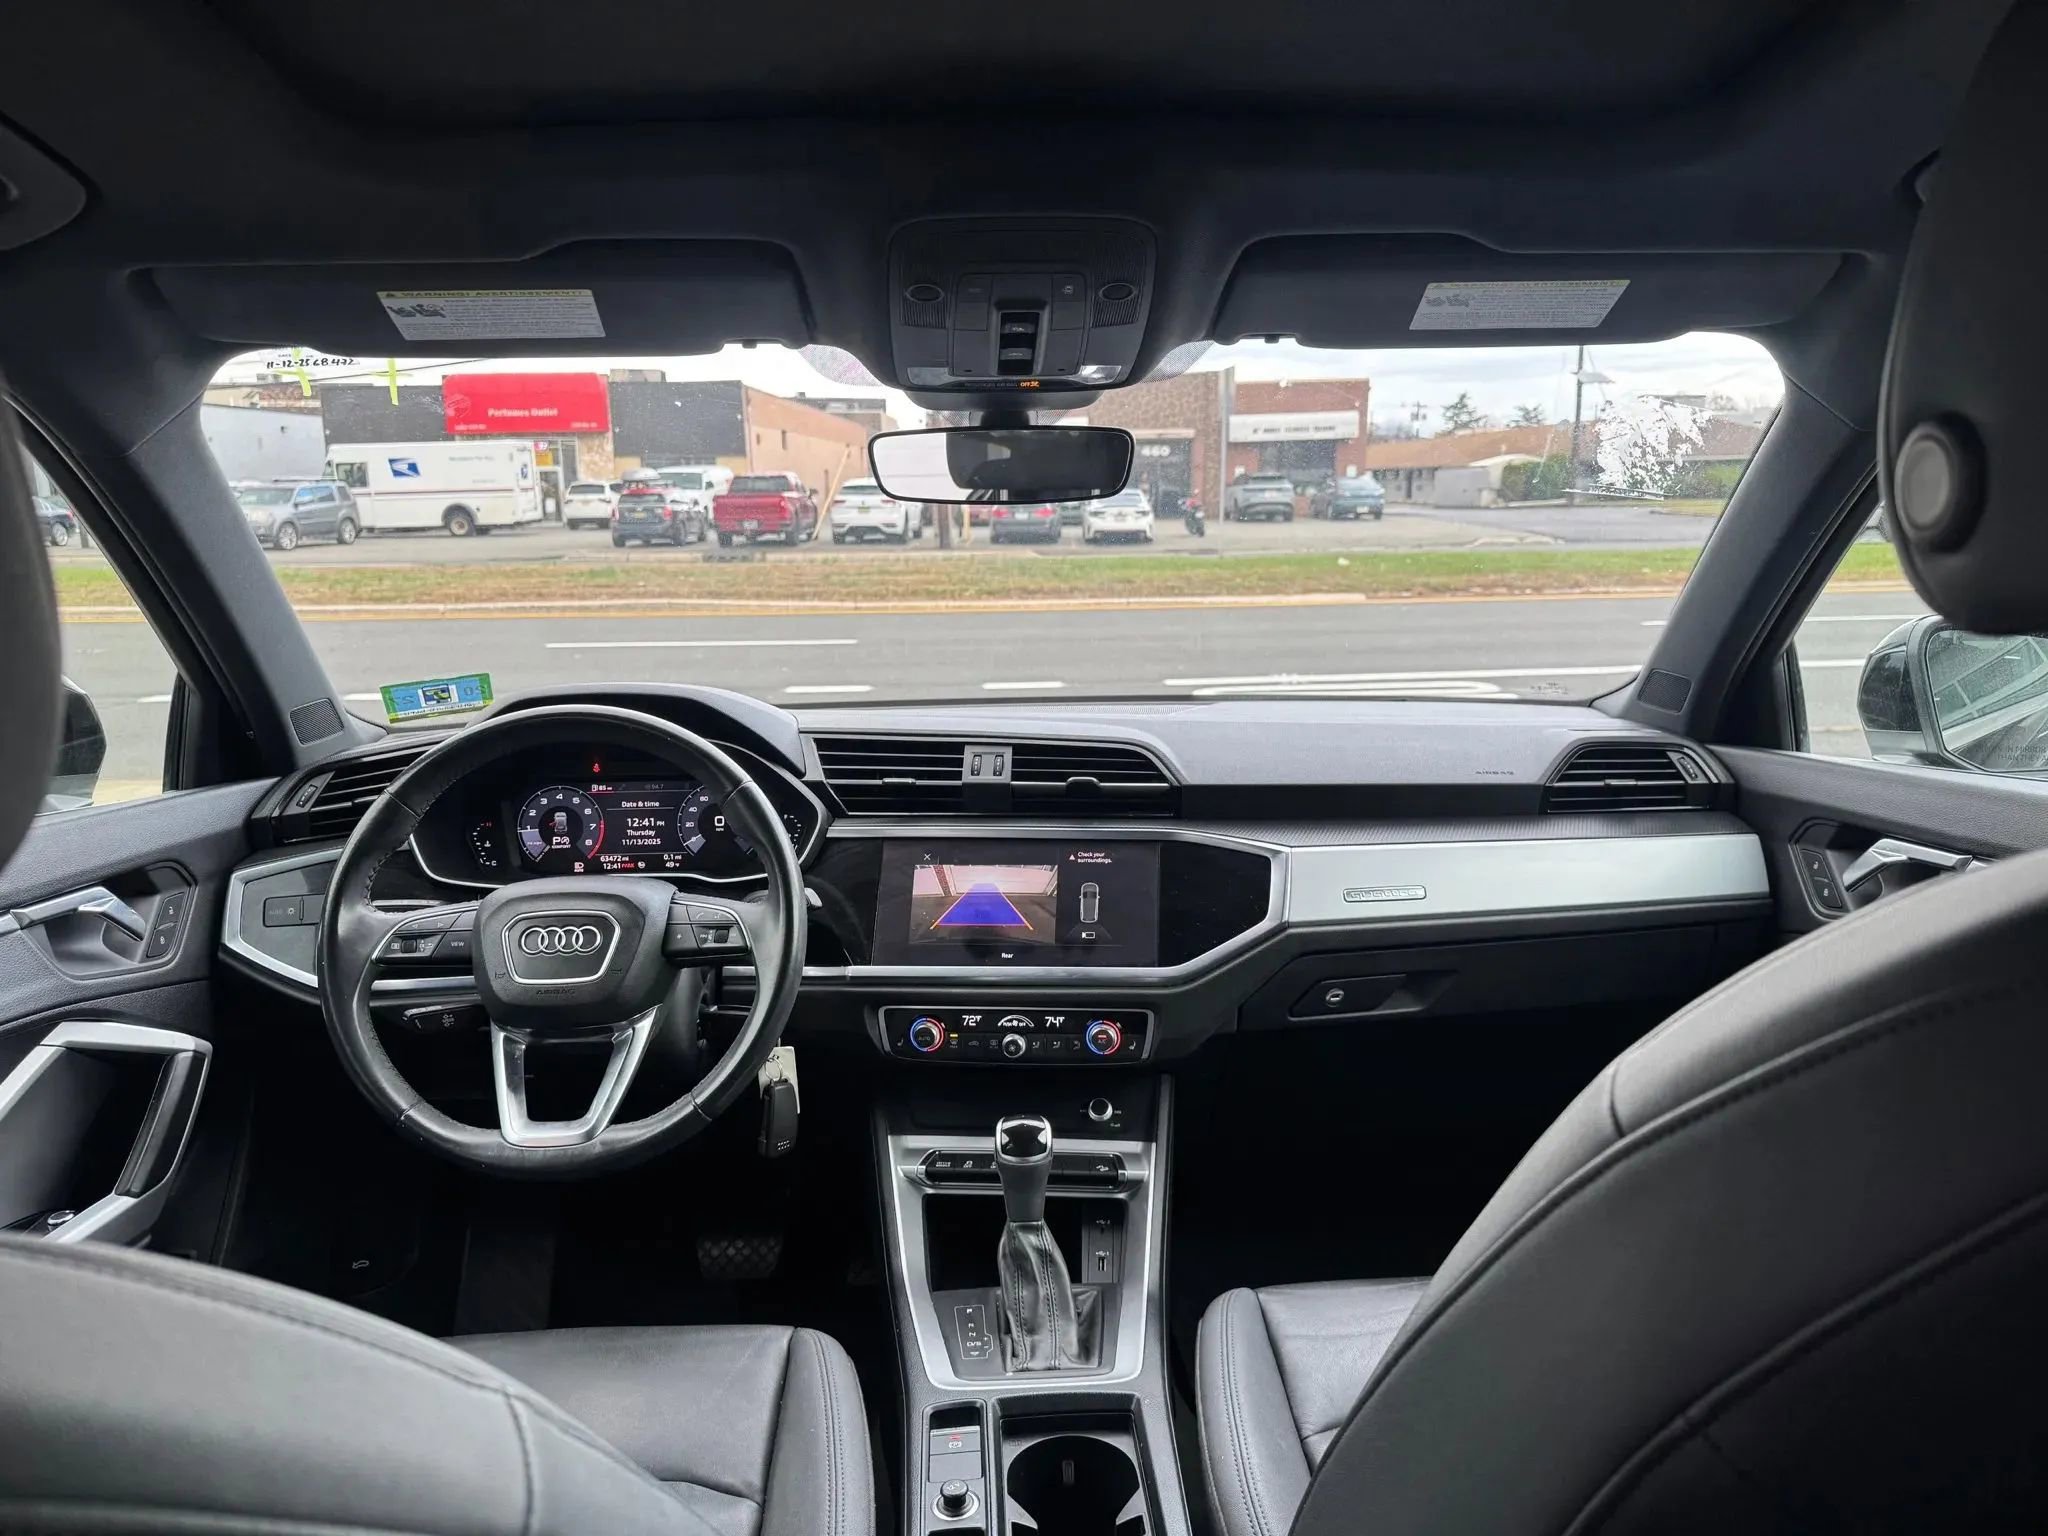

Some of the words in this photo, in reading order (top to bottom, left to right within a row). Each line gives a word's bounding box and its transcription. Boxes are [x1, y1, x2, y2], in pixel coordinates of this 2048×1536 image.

[530, 407, 558, 417] Outlet
[626, 817, 655, 827] 12:41
[714, 815, 725, 827] 0
[626, 829, 656, 837] Thursday
[552, 836, 561, 845] P
[621, 838, 662, 846] 11/13/2025
